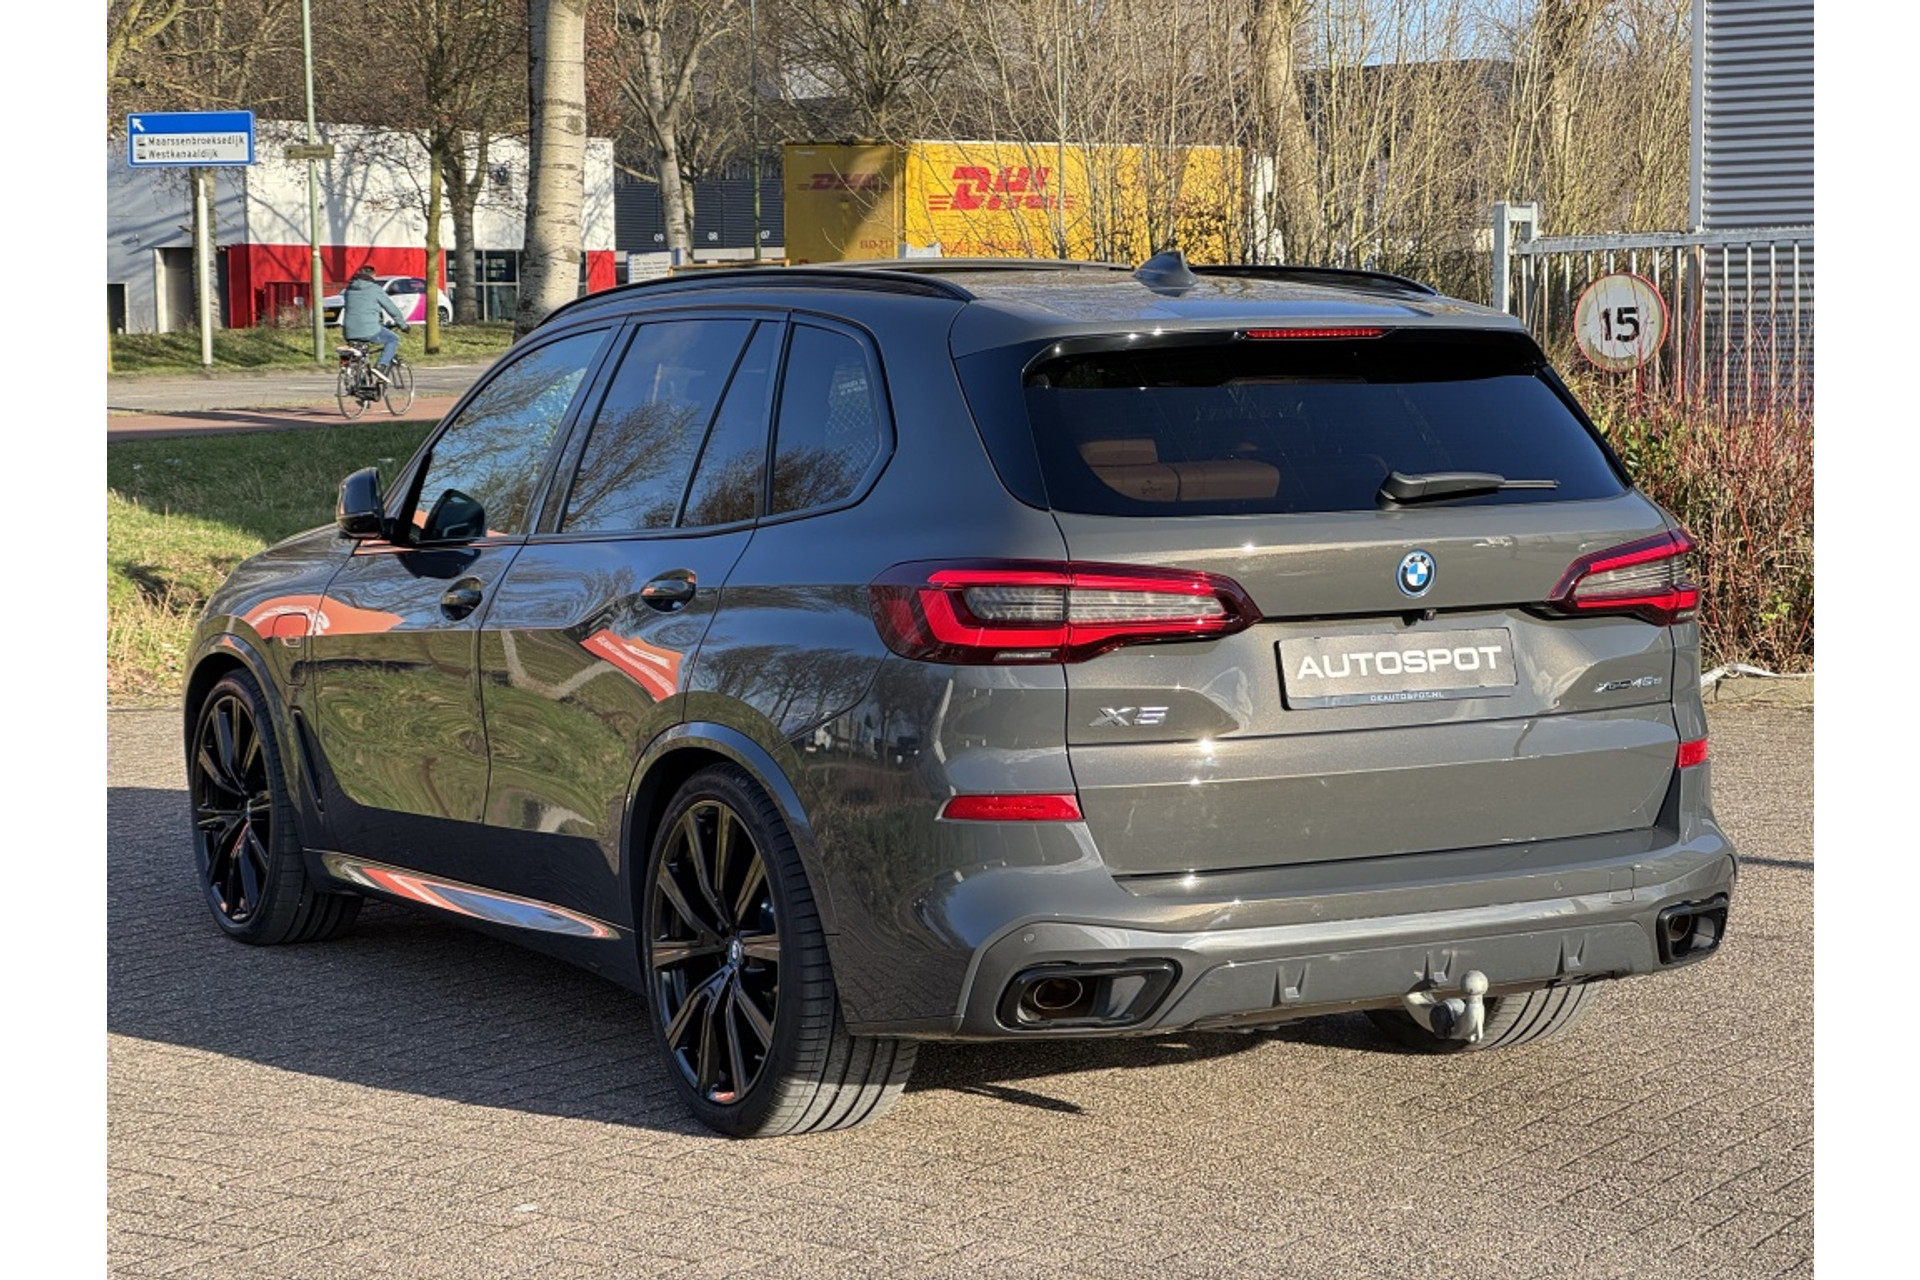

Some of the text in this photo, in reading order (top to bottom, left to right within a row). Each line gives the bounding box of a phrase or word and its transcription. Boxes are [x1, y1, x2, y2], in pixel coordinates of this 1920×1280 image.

[148, 135, 245, 148] Maarssenbroeksedijk
[148, 148, 219, 160] Westkanaaldijk
[951, 166, 1060, 211] DHL
[653, 233, 665, 243] 09
[760, 230, 771, 240] 07
[1602, 306, 1640, 342] 15
[1297, 645, 1502, 680] AUTOSPOT
[1088, 706, 1170, 727] X5
